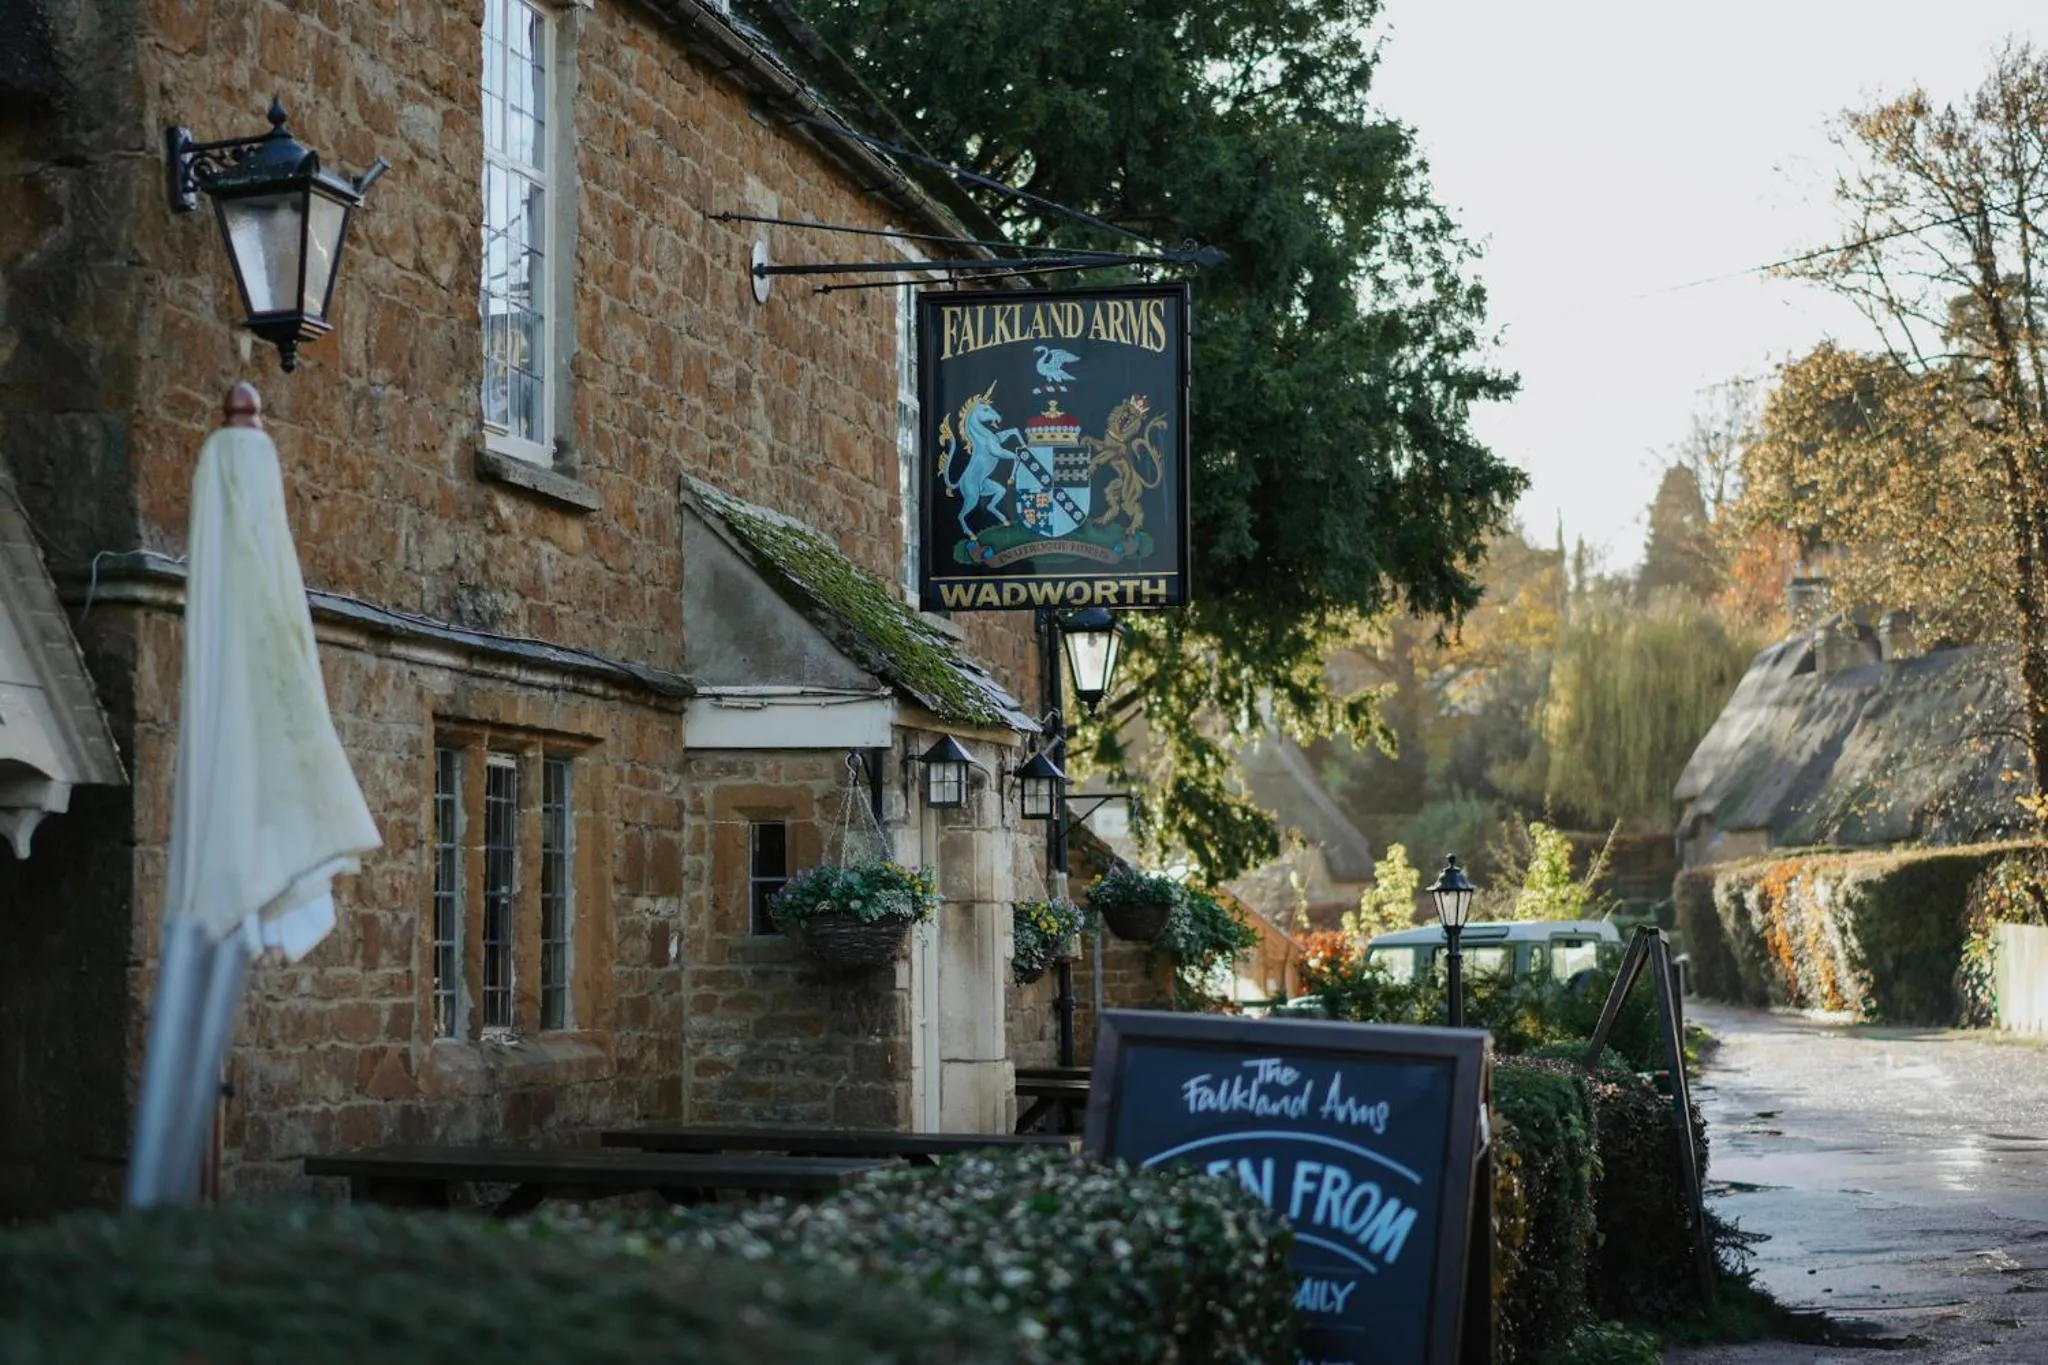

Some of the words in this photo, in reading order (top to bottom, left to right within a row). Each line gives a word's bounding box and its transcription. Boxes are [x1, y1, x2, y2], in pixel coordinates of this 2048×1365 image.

[940, 303, 1084, 360] FALKLAND
[1088, 299, 1167, 353] ARMS
[939, 579, 1167, 607] WADWORTH
[1242, 1057, 1300, 1086] The
[1182, 1074, 1314, 1119] Falkland
[1319, 1071, 1390, 1134] Arms
[1290, 1160, 1418, 1264] FROM
[1290, 1277, 1356, 1313] AILY
